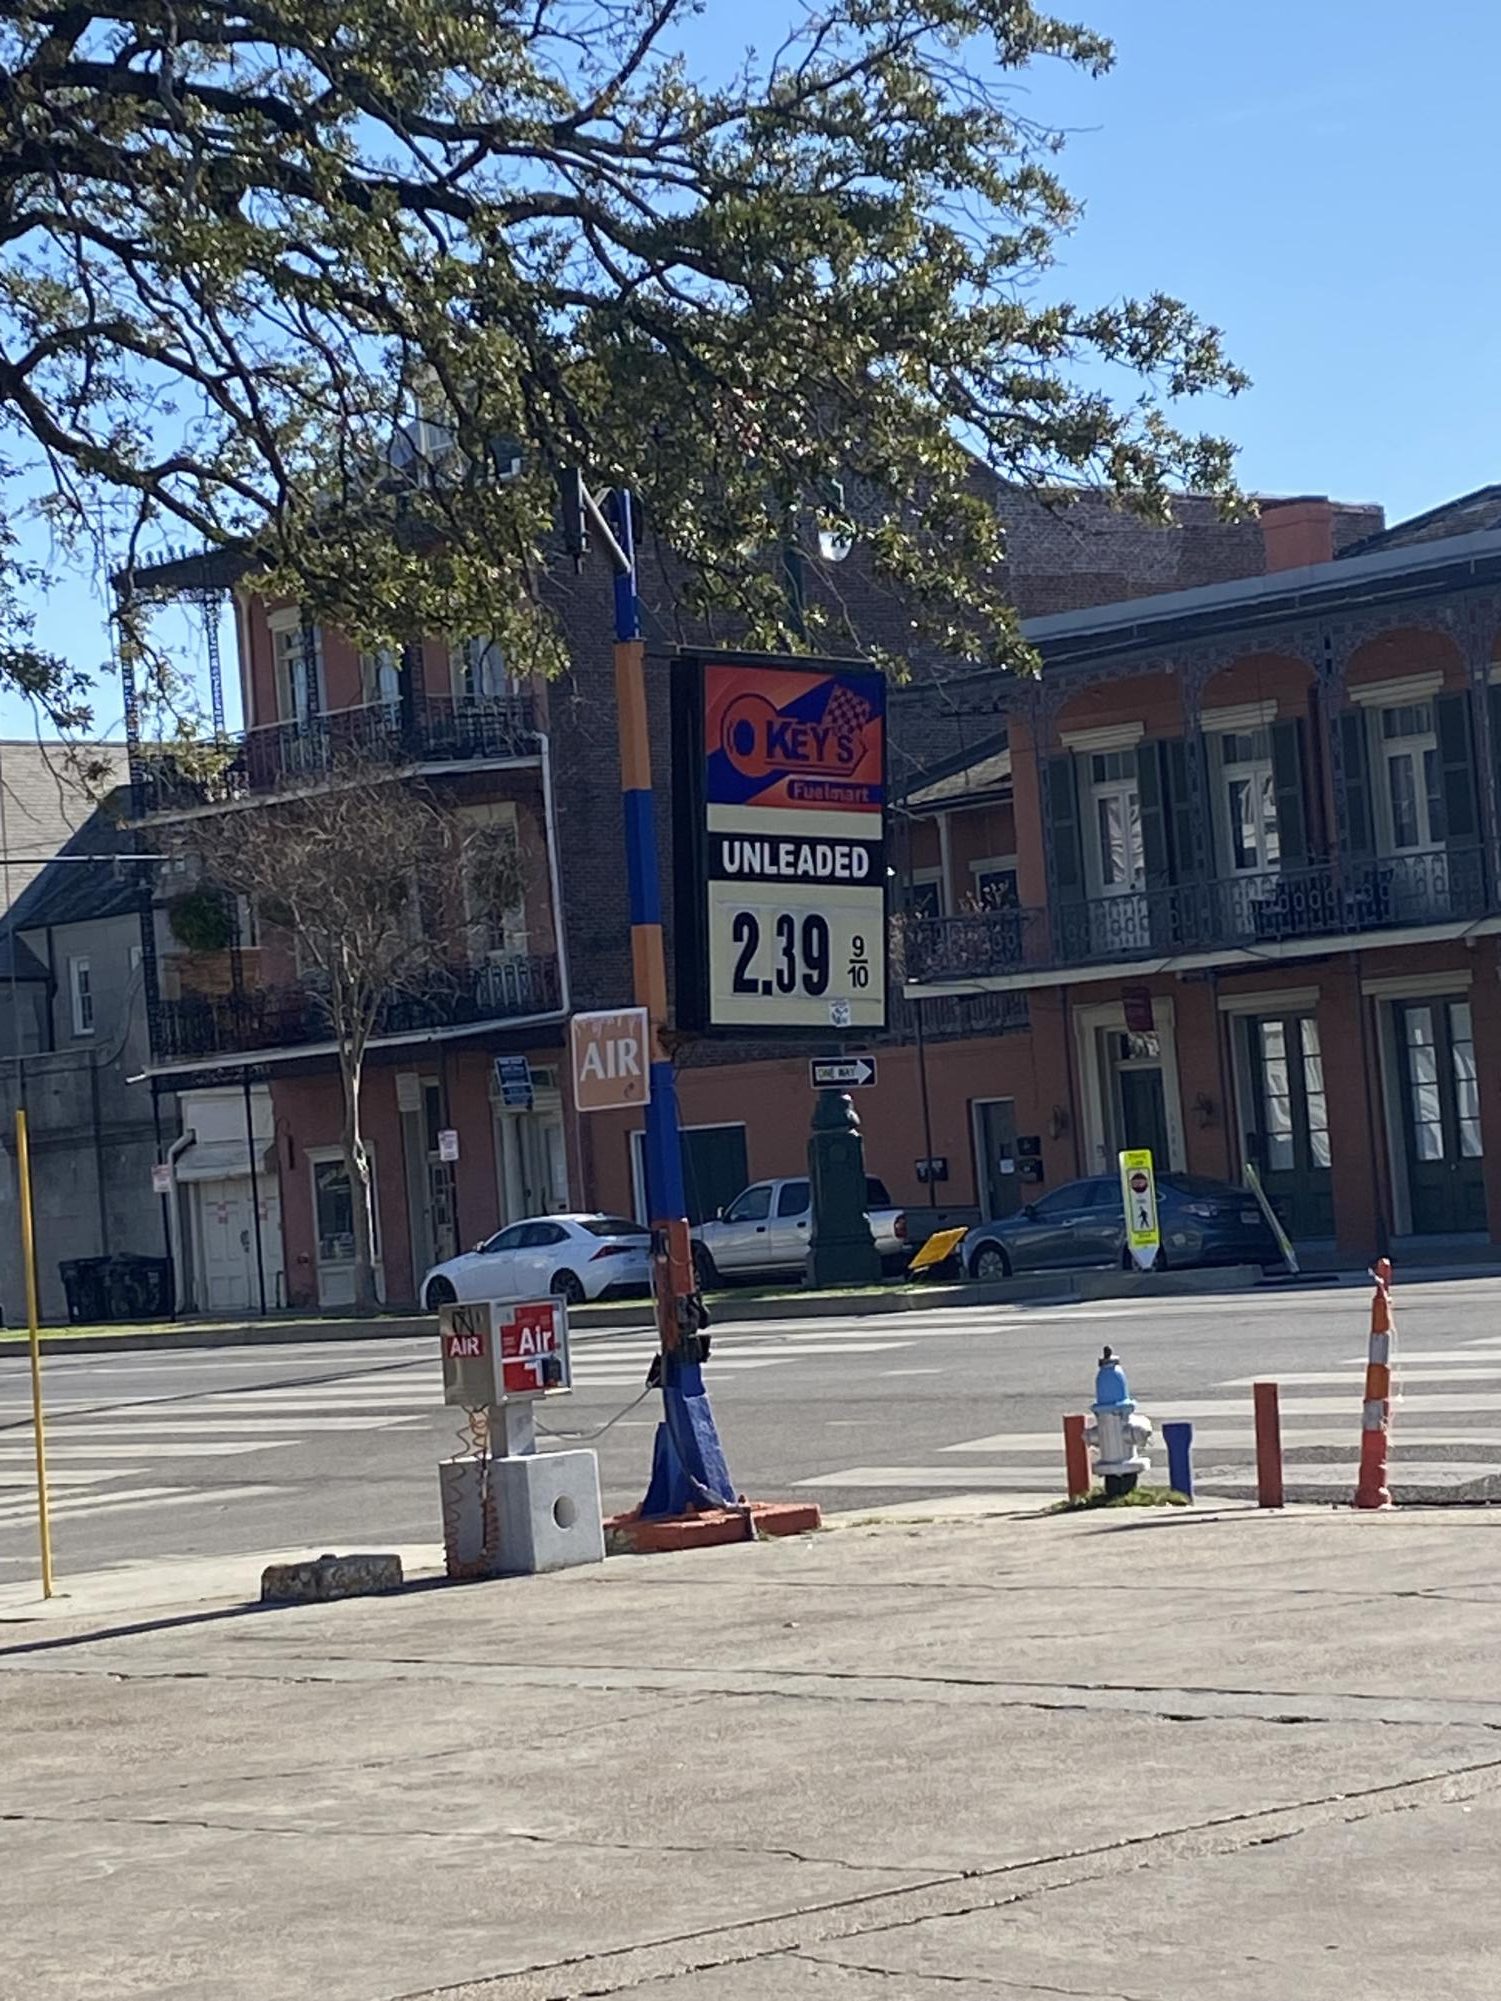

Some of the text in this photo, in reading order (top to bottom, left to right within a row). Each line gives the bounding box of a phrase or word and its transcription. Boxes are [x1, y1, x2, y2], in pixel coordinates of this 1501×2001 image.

[793, 781, 870, 802] Fuelmart
[722, 840, 869, 878] UNLEADED
[732, 911, 830, 997] 2.39
[852, 935, 865, 958] 9
[847, 965, 868, 988] 10
[579, 1037, 642, 1082] AIR
[449, 1337, 480, 1357] AIR
[518, 1325, 552, 1355] Air
